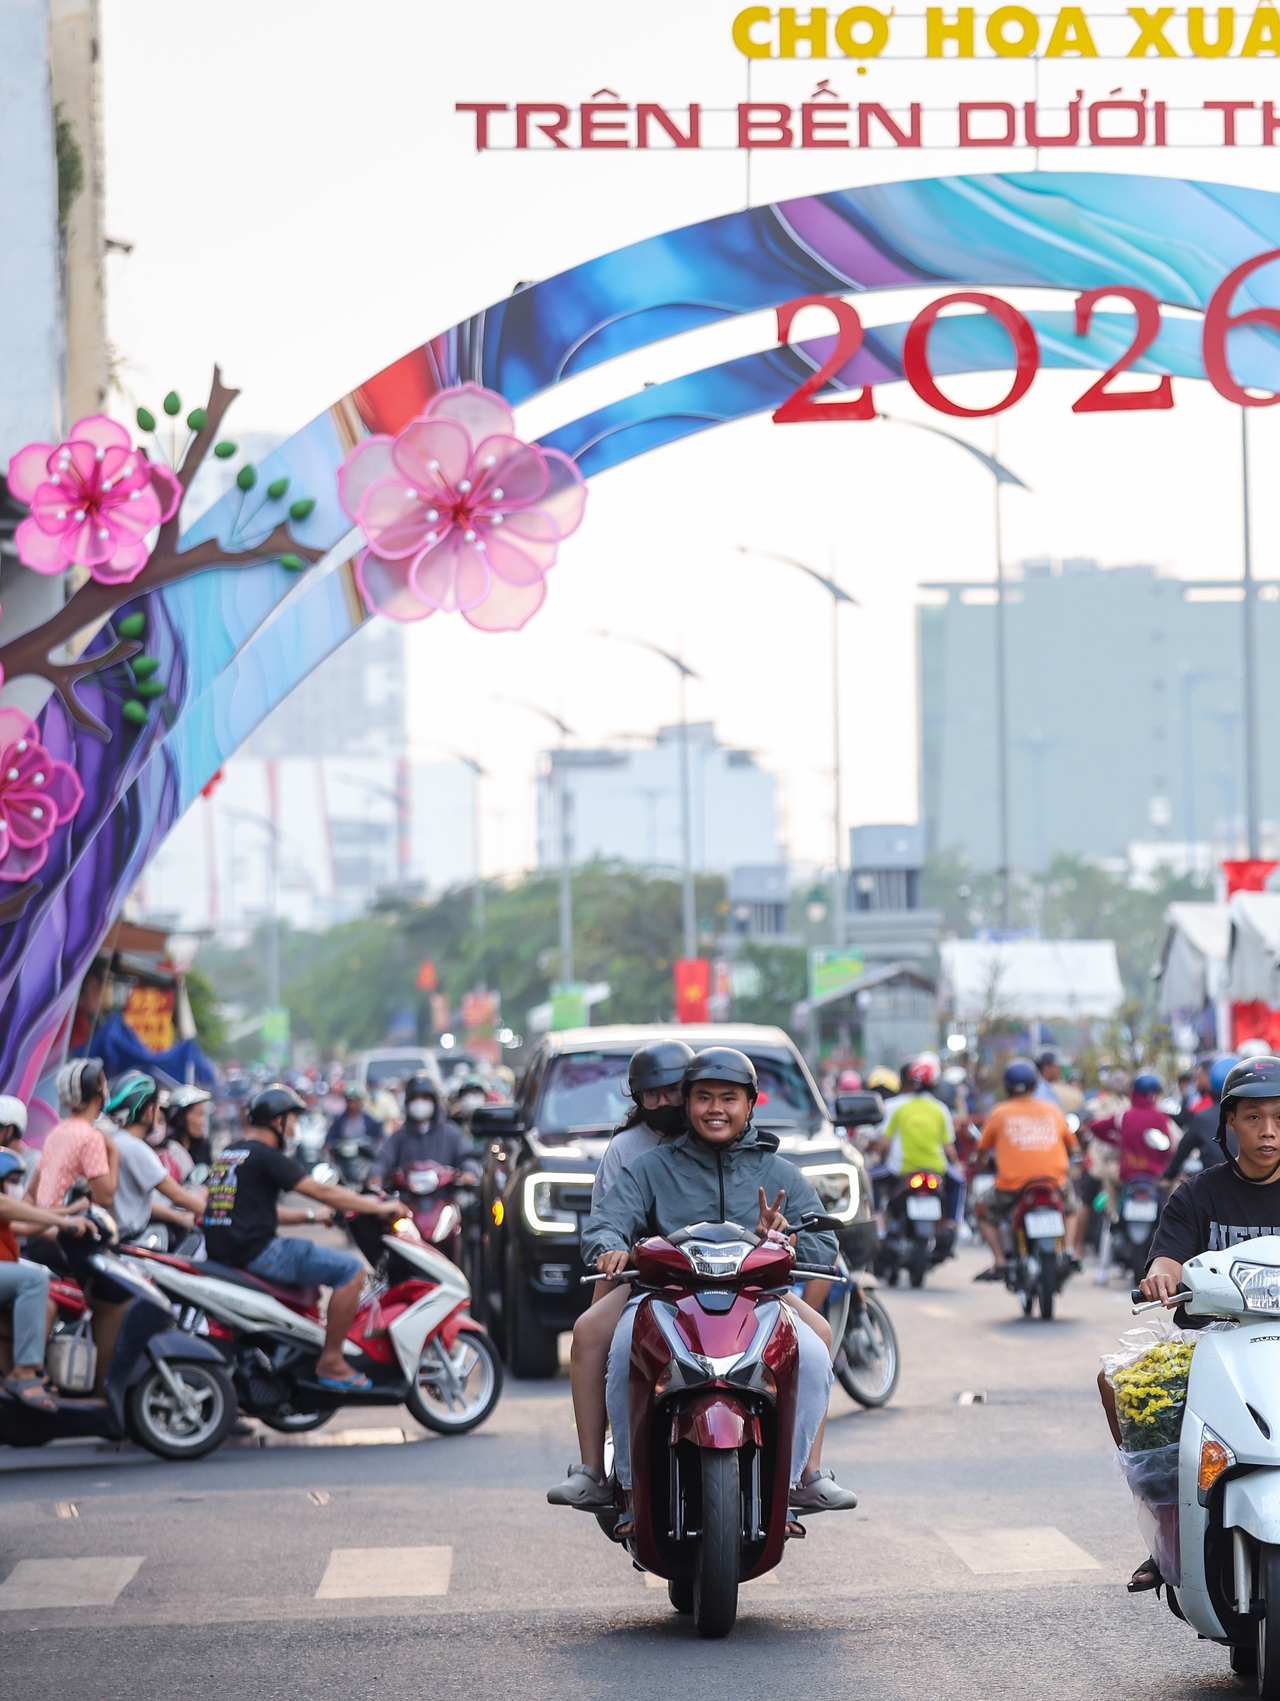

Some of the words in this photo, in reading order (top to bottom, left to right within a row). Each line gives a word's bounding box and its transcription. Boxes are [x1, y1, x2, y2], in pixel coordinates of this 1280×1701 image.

[732, 6, 895, 75] CHỢ
[926, 6, 1098, 58] HOA
[455, 87, 700, 149] TRÊN
[737, 79, 921, 149] BẾN
[958, 87, 1166, 148] DƯỚI
